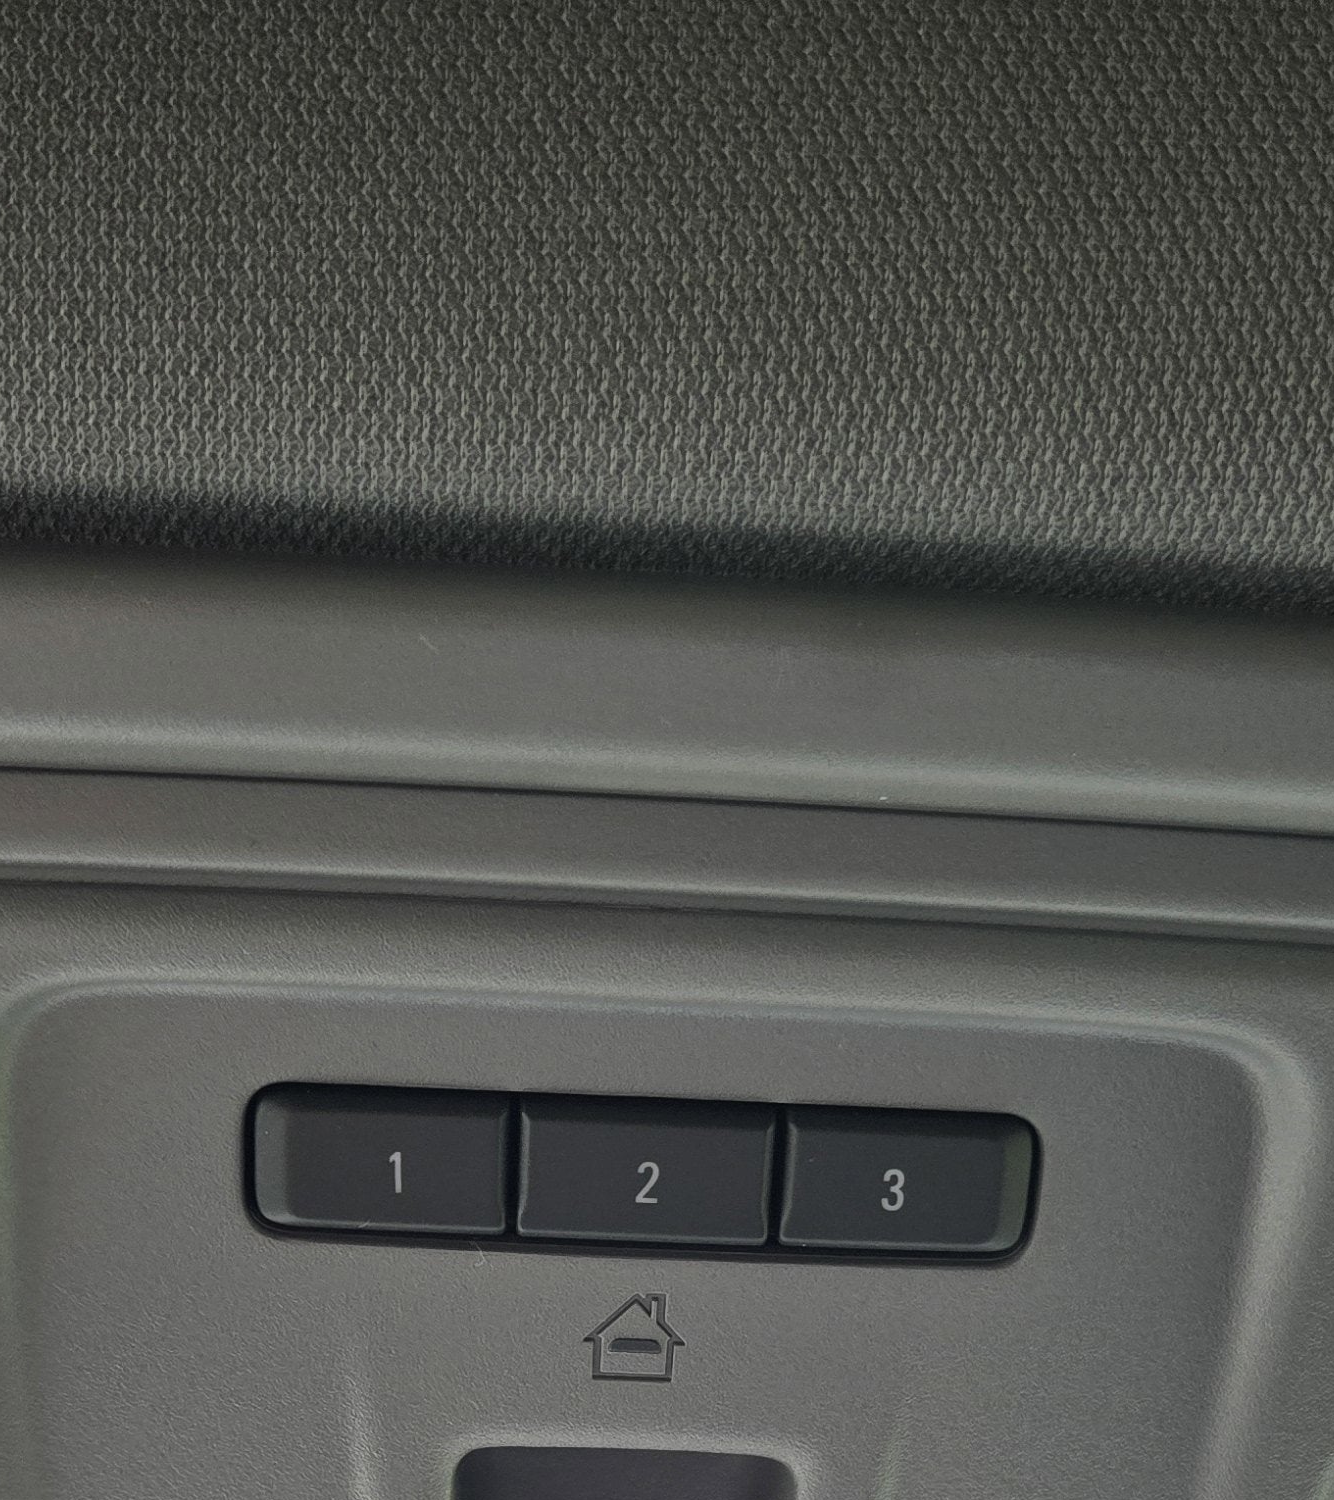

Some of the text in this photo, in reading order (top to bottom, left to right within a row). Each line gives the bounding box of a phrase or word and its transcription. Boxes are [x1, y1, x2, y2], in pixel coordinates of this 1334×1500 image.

[388, 1151, 404, 1194] 1
[635, 1161, 660, 1205] 2
[880, 1169, 906, 1212] 3
